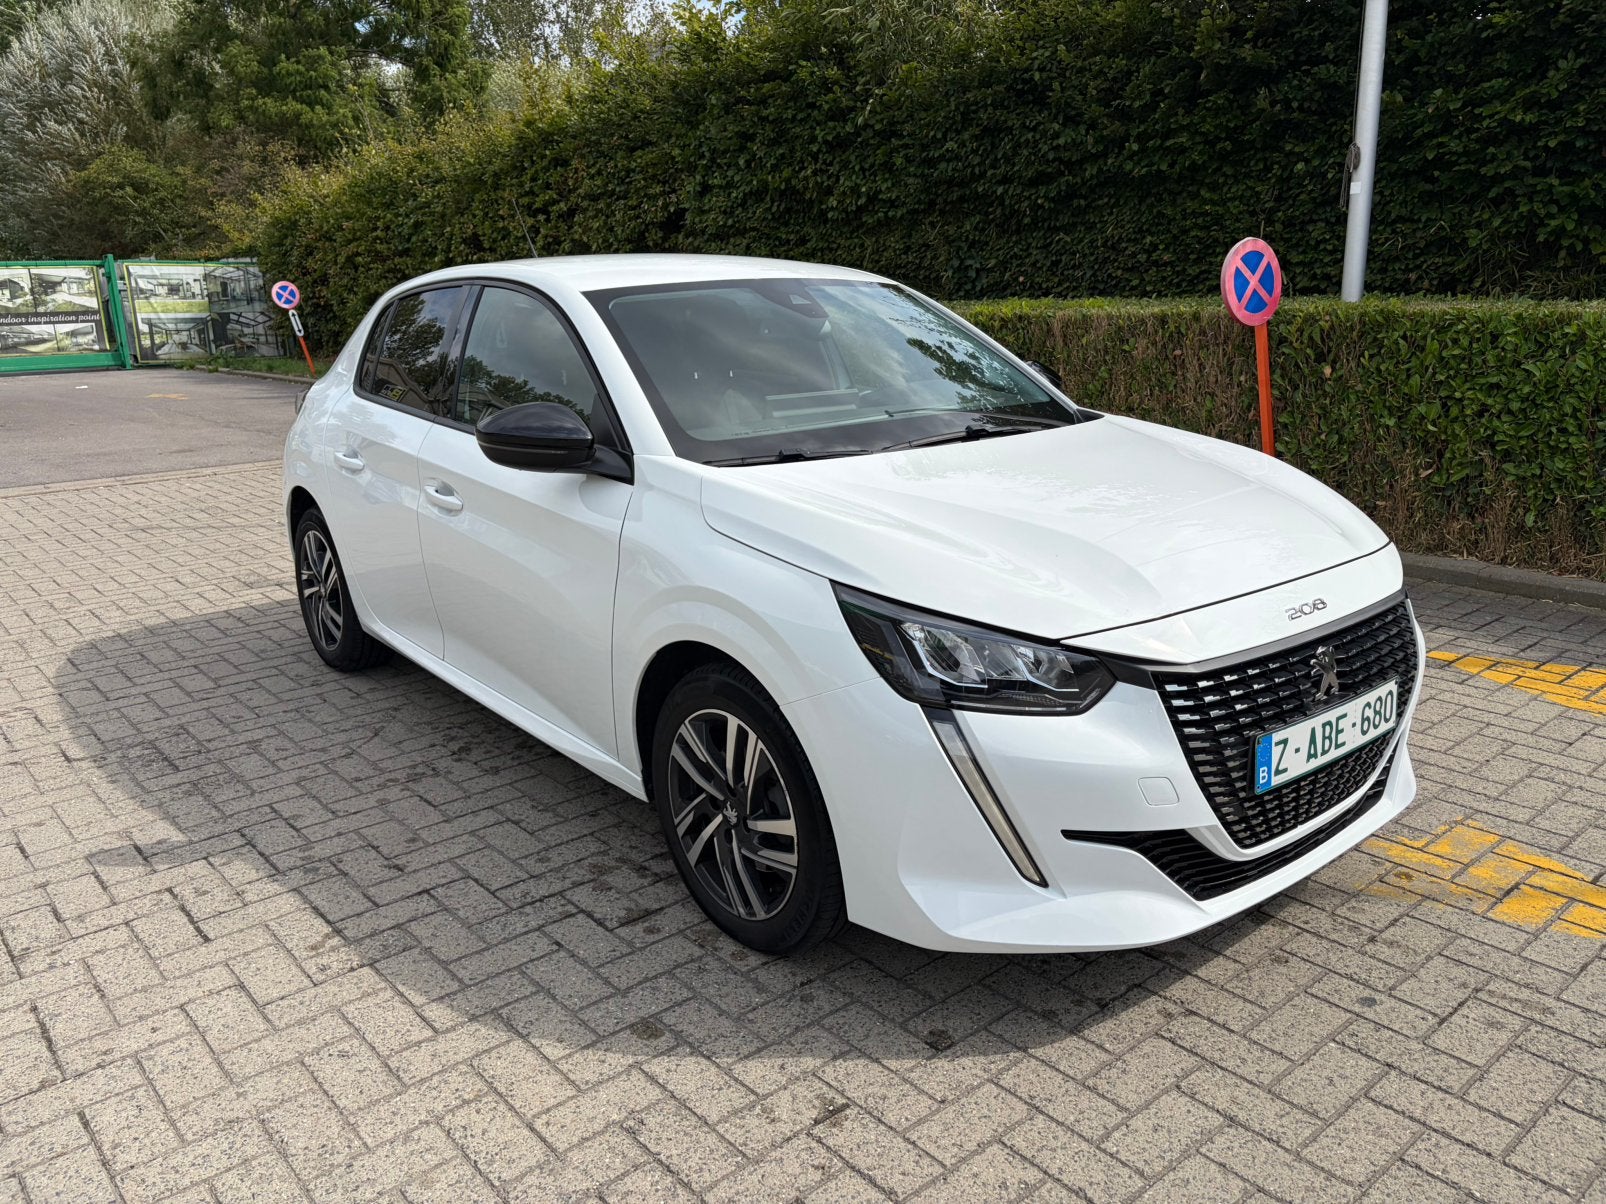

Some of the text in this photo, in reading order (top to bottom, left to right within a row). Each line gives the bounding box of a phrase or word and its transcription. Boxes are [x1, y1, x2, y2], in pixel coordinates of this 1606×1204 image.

[28, 314, 76, 324] inspiration
[78, 313, 100, 322] point
[1285, 598, 1327, 621] 208
[1274, 690, 1394, 777] Z-ABE-680
[1259, 766, 1268, 785] B
